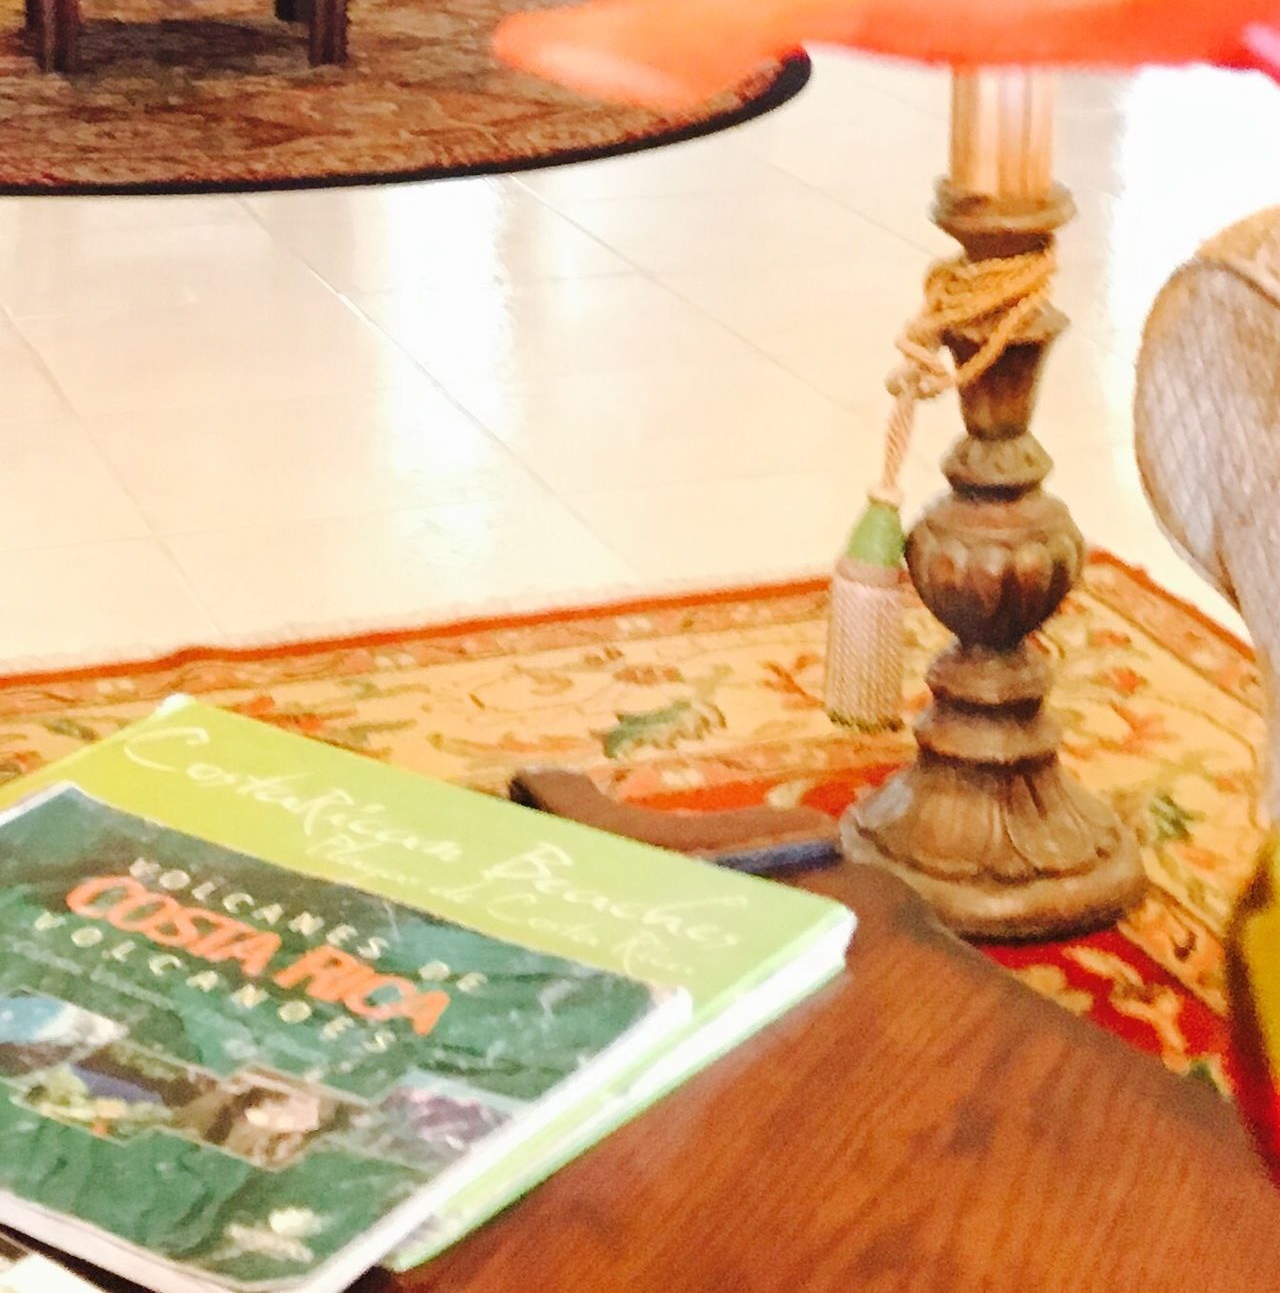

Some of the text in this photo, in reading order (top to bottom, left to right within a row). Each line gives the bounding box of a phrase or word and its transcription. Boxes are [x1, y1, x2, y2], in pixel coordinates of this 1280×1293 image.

[65, 874, 283, 978] COSTA
[272, 944, 452, 1038] RICA
[128, 856, 391, 960] VOLCANES
[33, 910, 398, 1054] VOLCANOES
